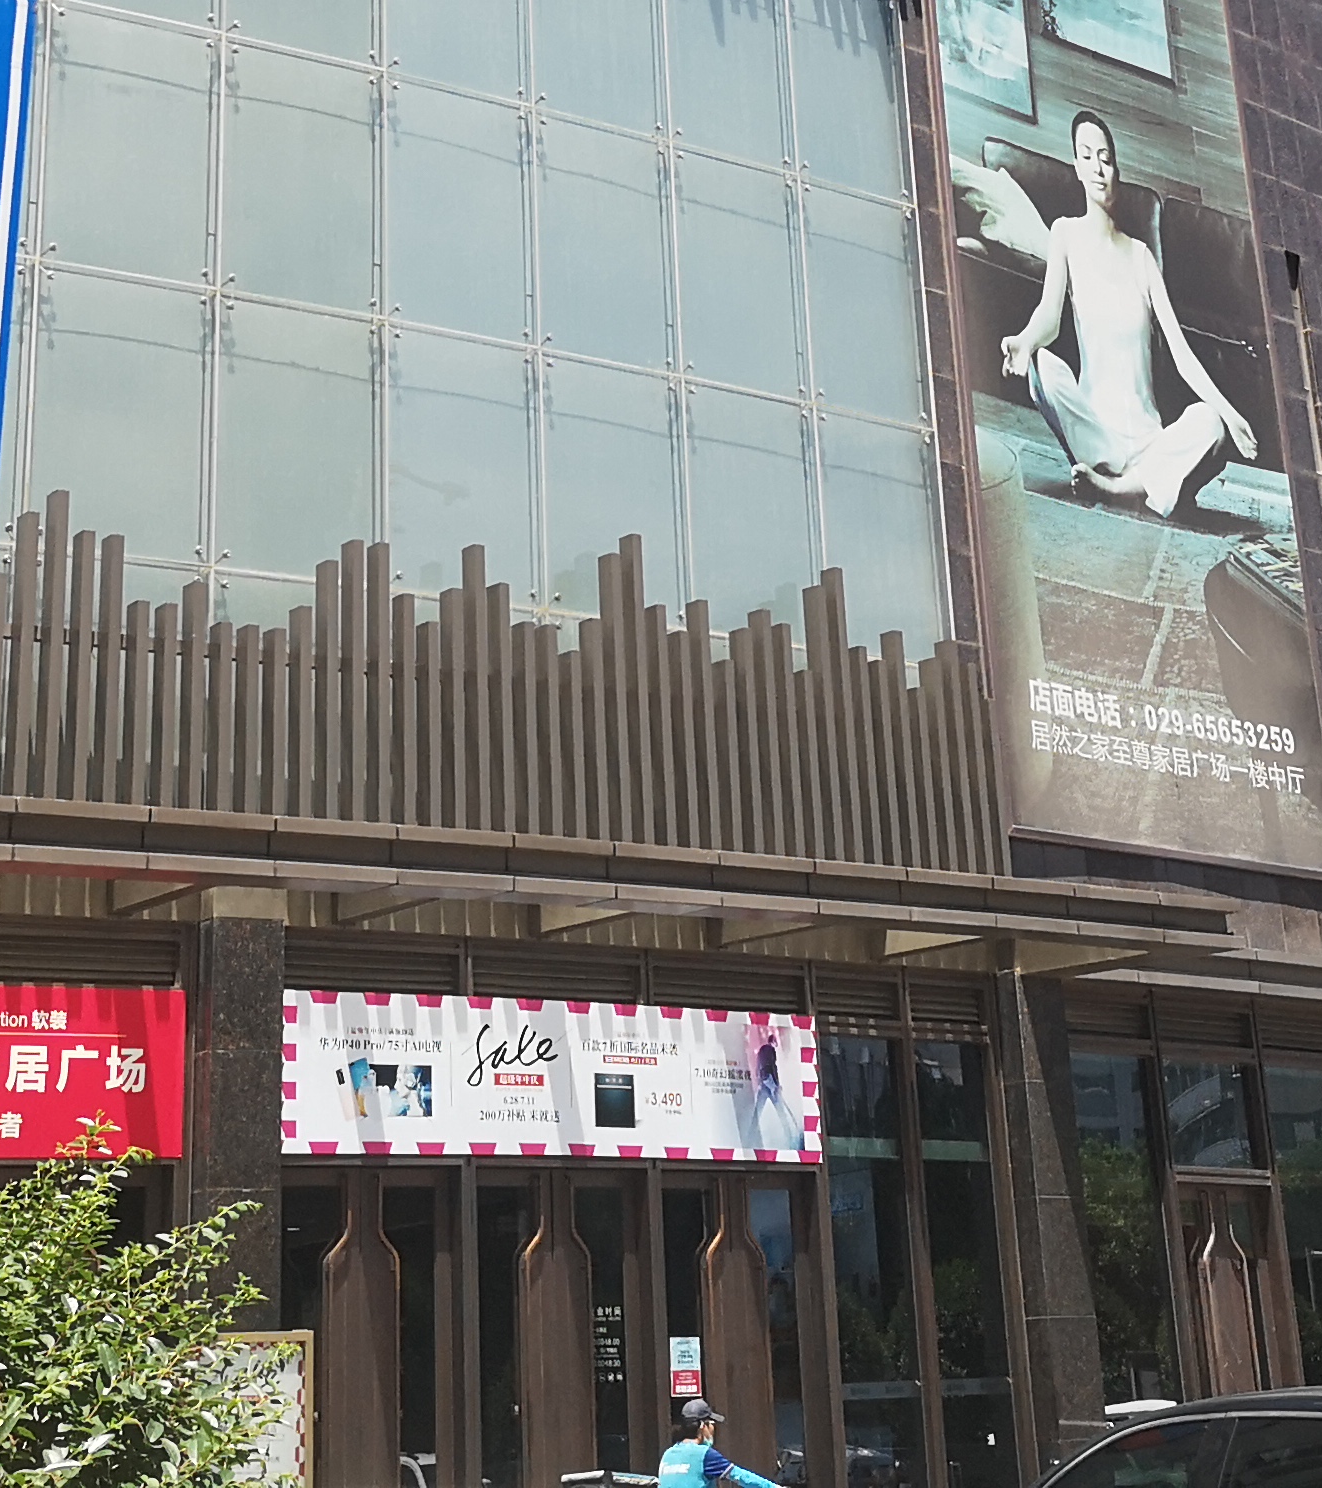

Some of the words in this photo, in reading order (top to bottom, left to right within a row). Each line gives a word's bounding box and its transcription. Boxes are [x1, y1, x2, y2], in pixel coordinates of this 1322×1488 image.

[1031, 720, 1305, 795] 居然之家至尊家居广场一楼中厅
[31, 1009, 69, 1031] 软装
